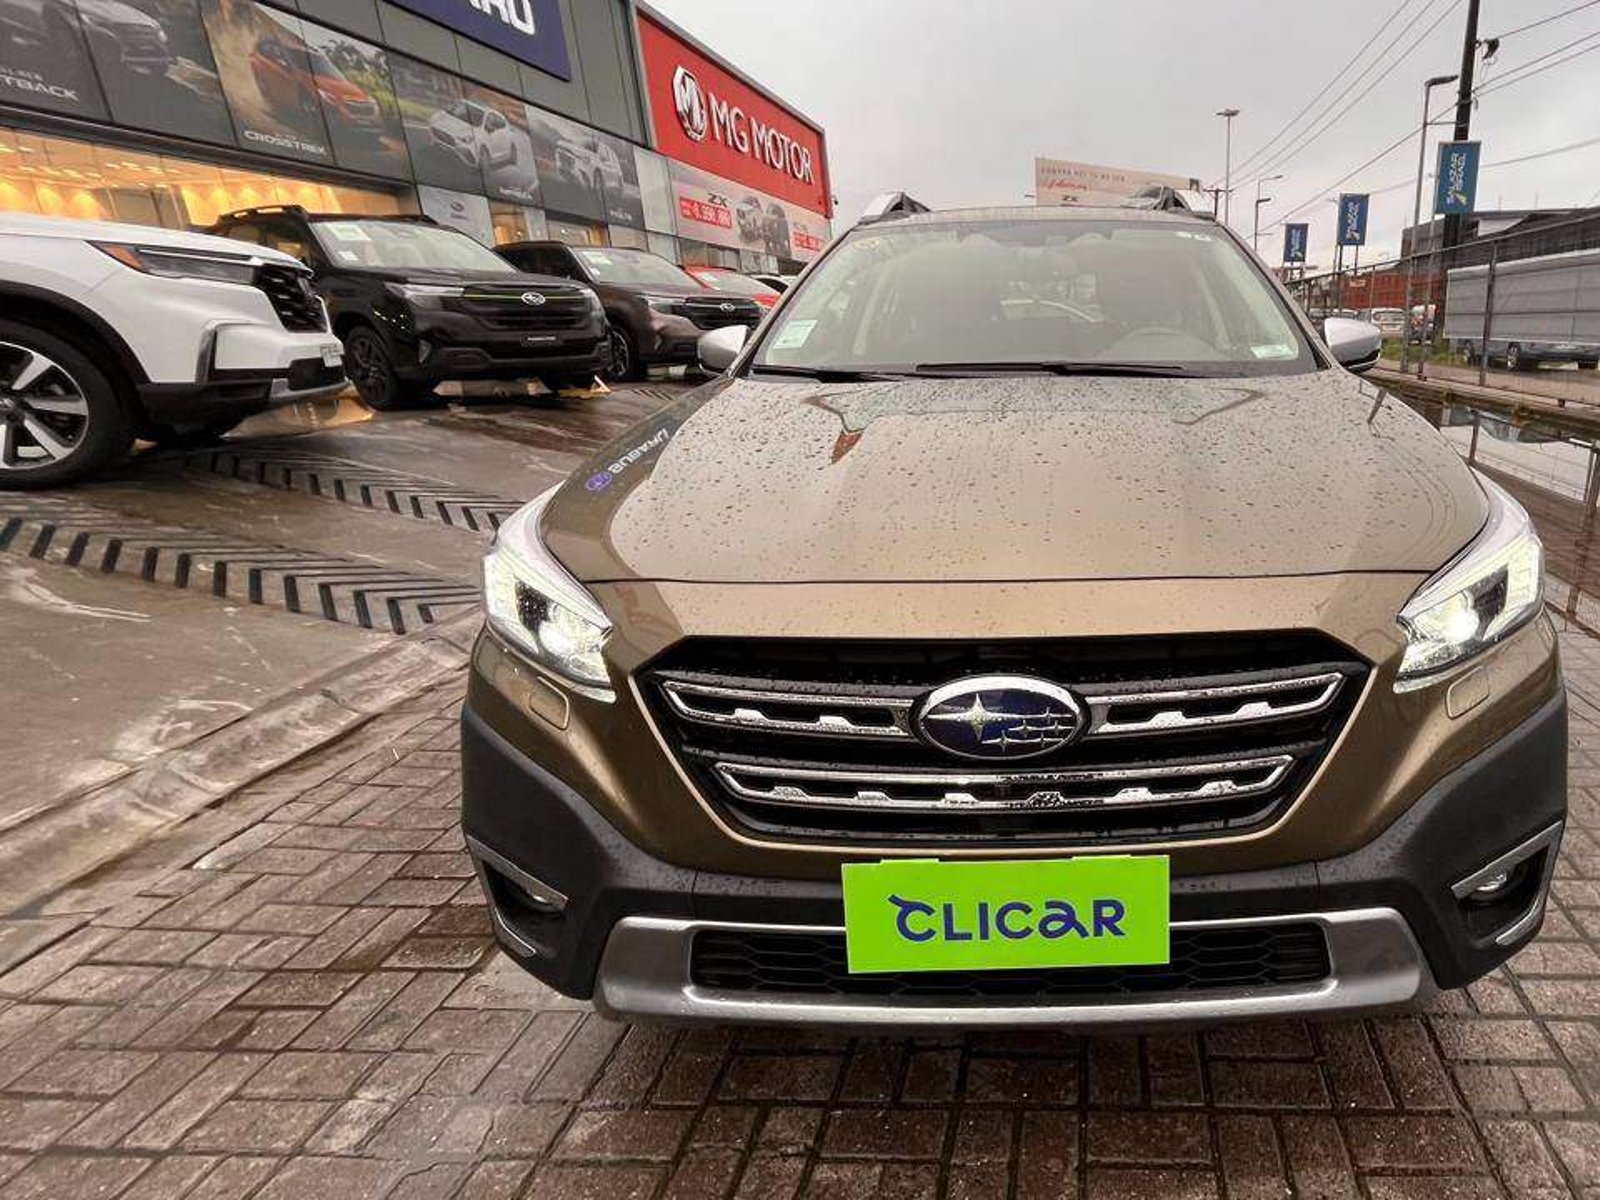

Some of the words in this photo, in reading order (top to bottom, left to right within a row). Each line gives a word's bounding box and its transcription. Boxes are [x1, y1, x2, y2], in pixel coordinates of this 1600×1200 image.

[708, 92, 749, 153] MG
[751, 117, 814, 185] MOTOR
[707, 192, 728, 208] ZX
